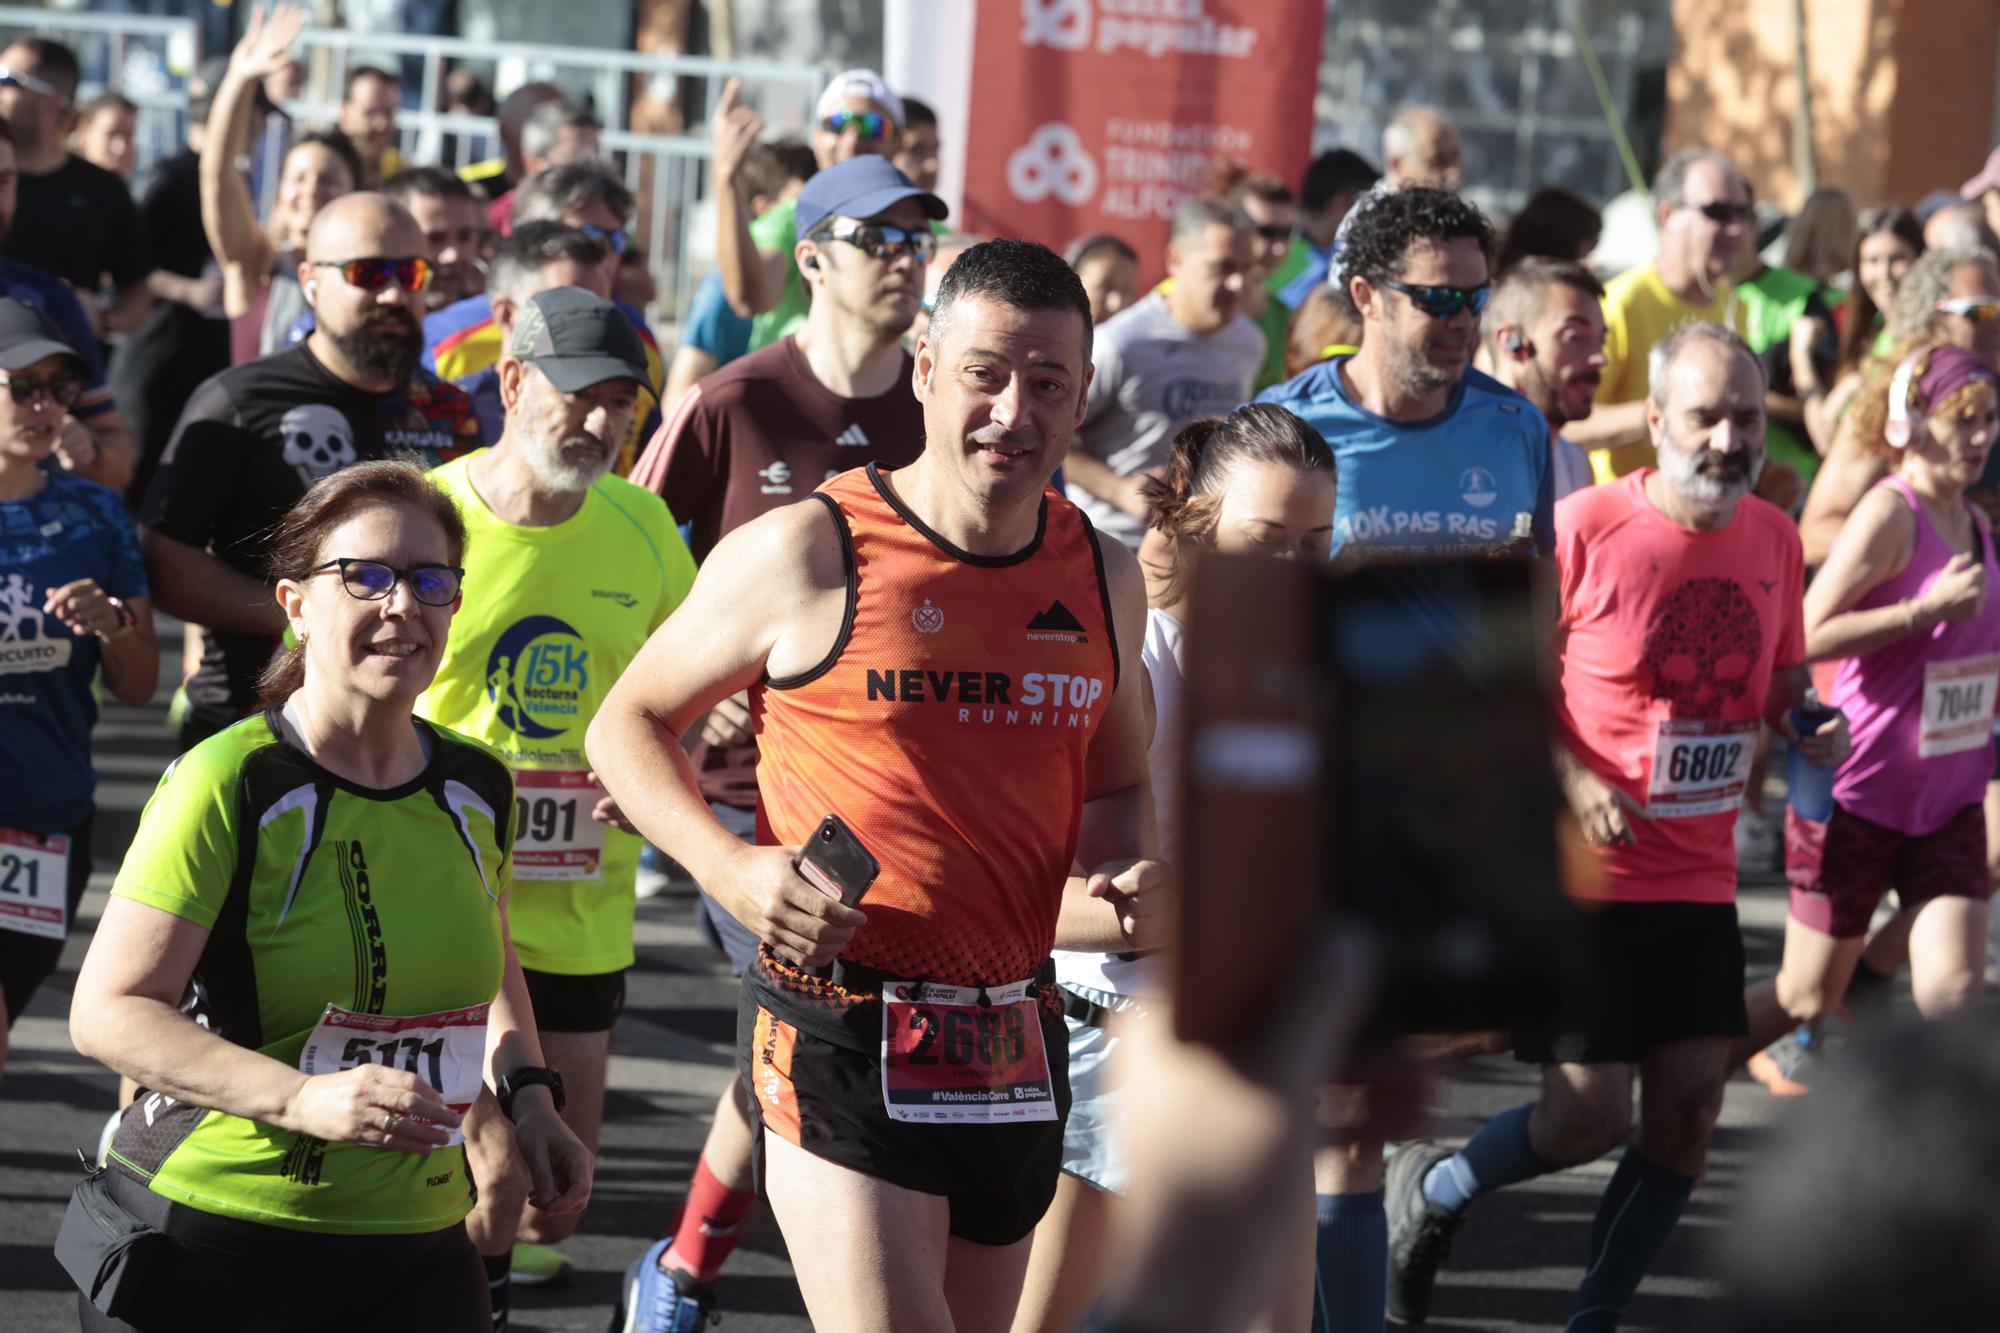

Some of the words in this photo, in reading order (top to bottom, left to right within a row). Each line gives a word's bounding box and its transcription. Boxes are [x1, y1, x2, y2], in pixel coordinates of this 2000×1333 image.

[1392, 510, 1440, 534] PAS
[1447, 511, 1498, 540] RAS
[1026, 632, 1089, 644] neverstop.es
[524, 687, 577, 699] Nocturna
[866, 668, 1013, 705] NEVER
[1020, 672, 1103, 709] STOP
[525, 700, 578, 715] Valencia
[1668, 742, 1742, 783] 6802
[908, 1007, 1024, 1065] 2688
